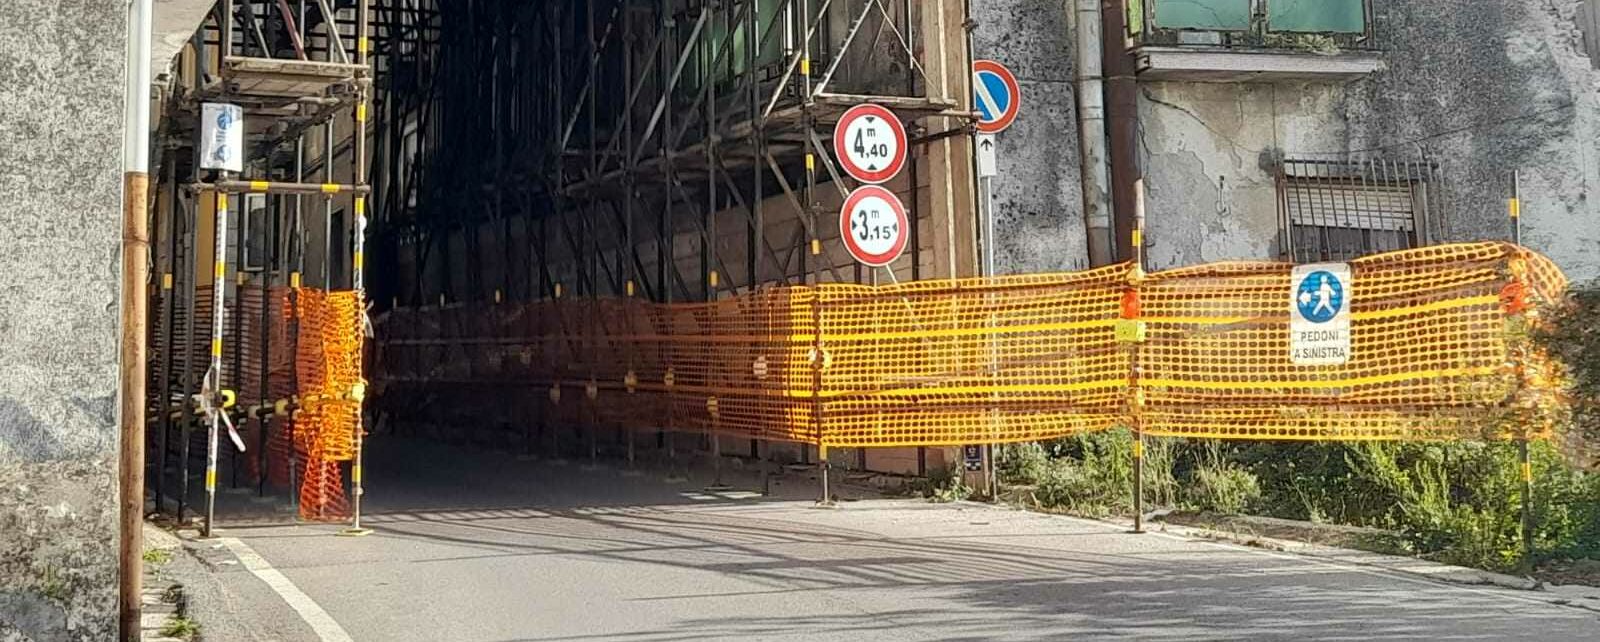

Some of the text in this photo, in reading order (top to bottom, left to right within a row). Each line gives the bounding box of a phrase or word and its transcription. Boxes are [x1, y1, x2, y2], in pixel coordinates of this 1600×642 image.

[866, 128, 876, 137] m
[871, 210, 880, 219] m
[1301, 331, 1339, 342] PEDONI
[1294, 347, 1345, 359] A SINISTRA
